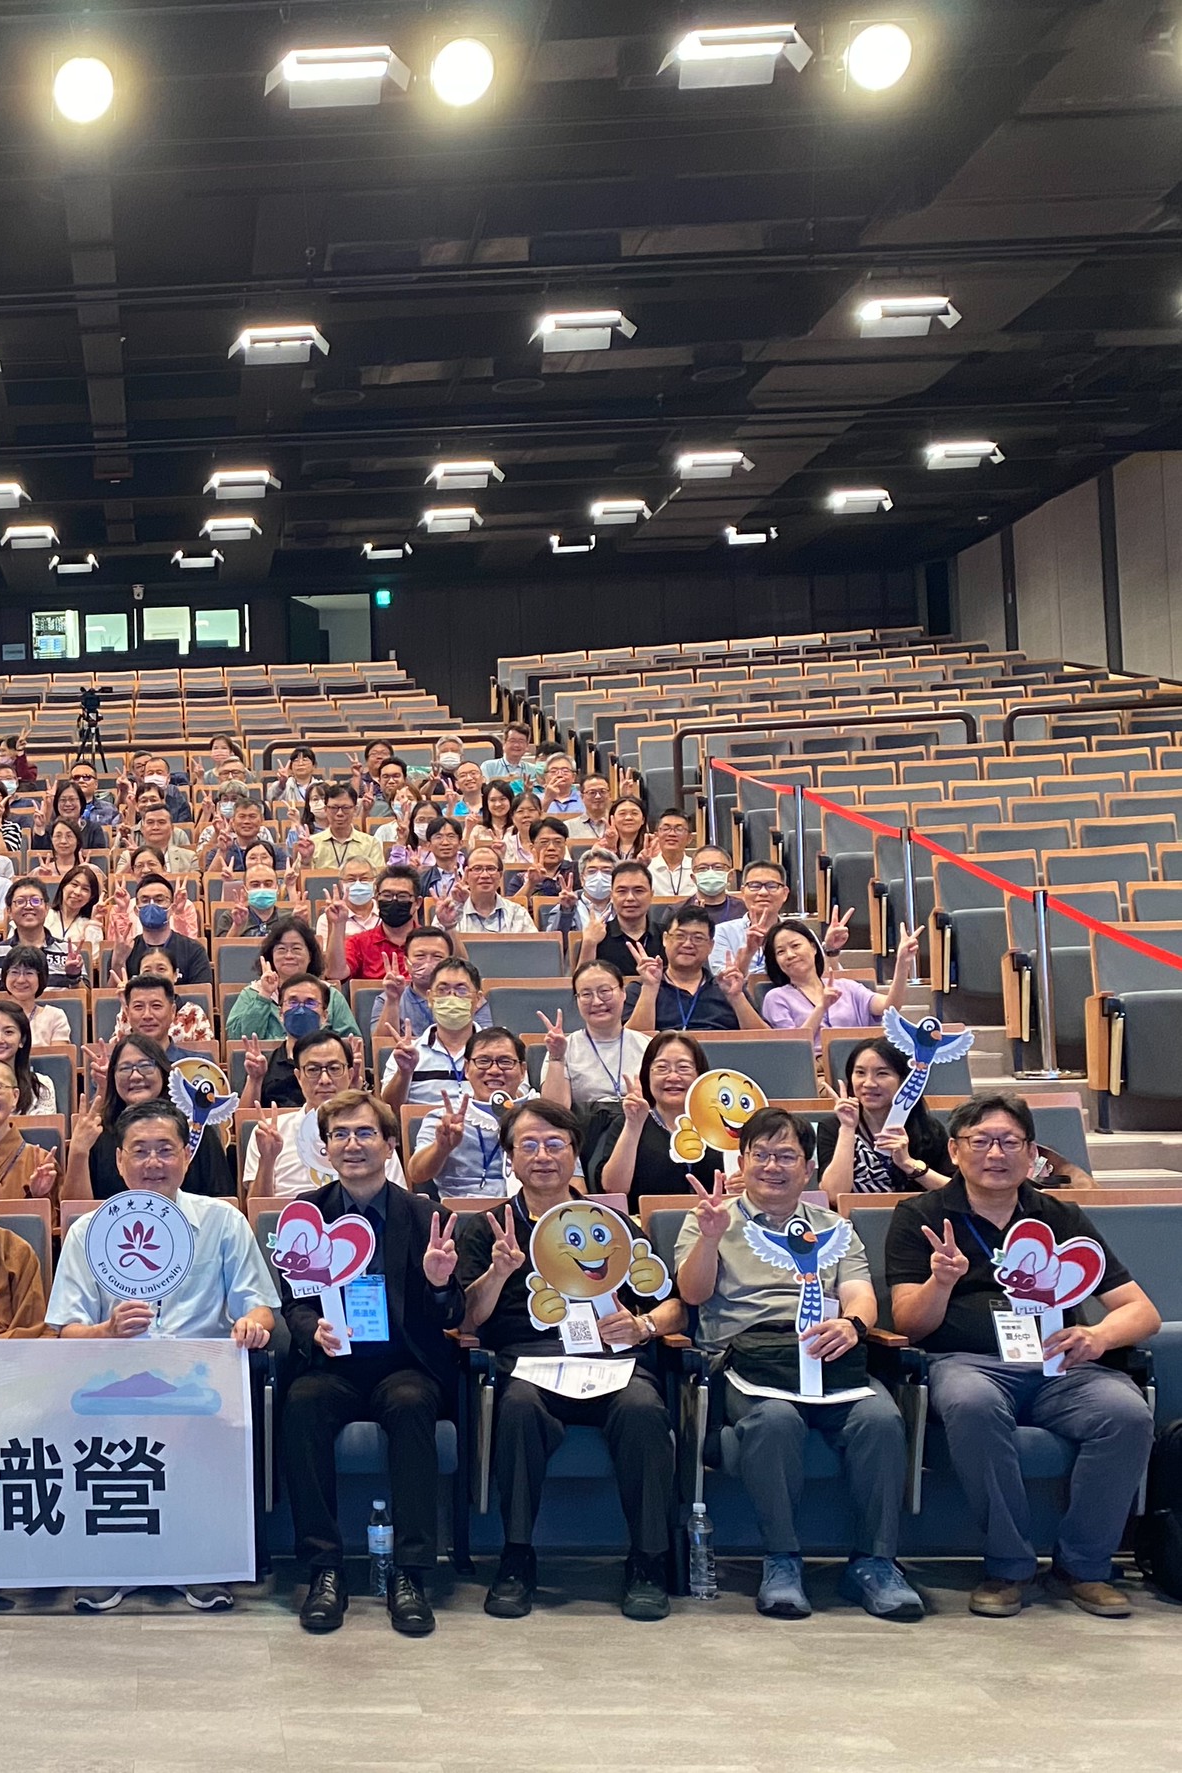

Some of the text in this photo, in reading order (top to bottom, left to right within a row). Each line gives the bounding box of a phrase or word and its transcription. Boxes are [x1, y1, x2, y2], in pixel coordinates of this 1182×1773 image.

[98, 1261, 183, 1296] Fo Guang University
